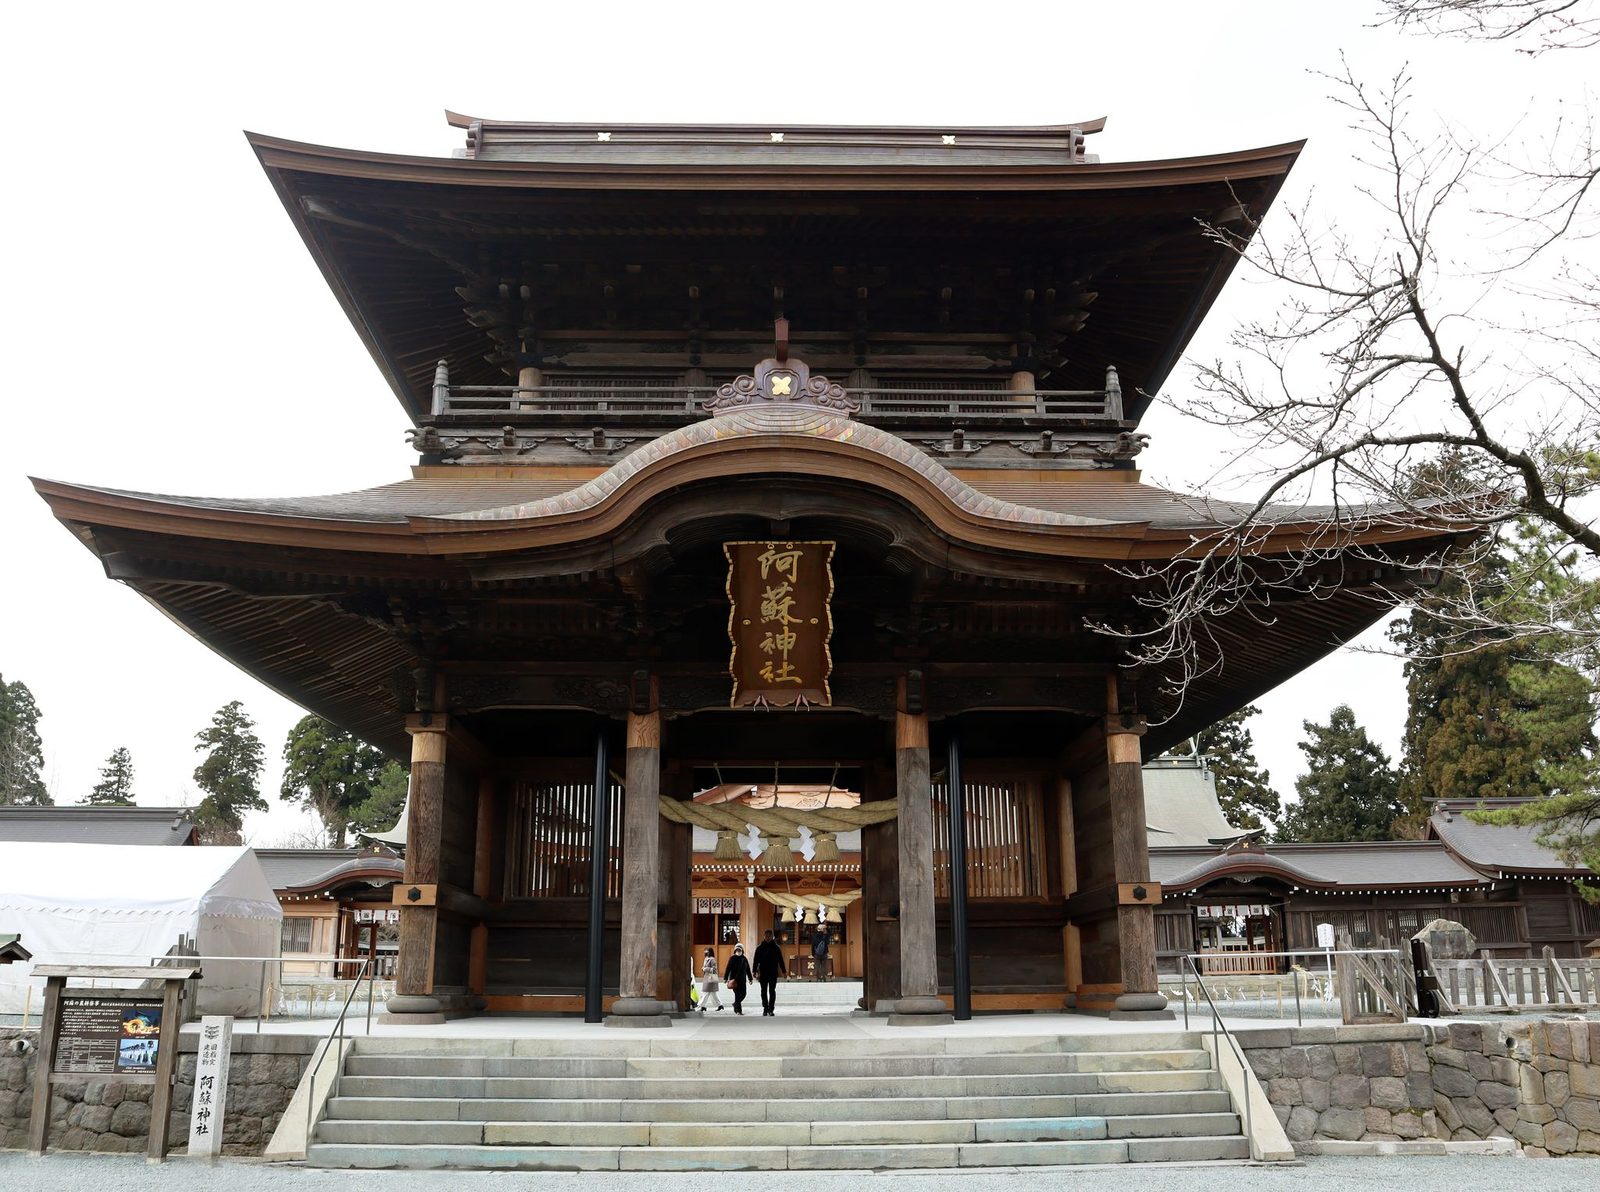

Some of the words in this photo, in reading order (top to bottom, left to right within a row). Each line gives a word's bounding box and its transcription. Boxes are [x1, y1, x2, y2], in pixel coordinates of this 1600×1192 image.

[757, 549, 804, 684] 阿蘇神社
[196, 1075, 215, 1136] 阿蘇神社
